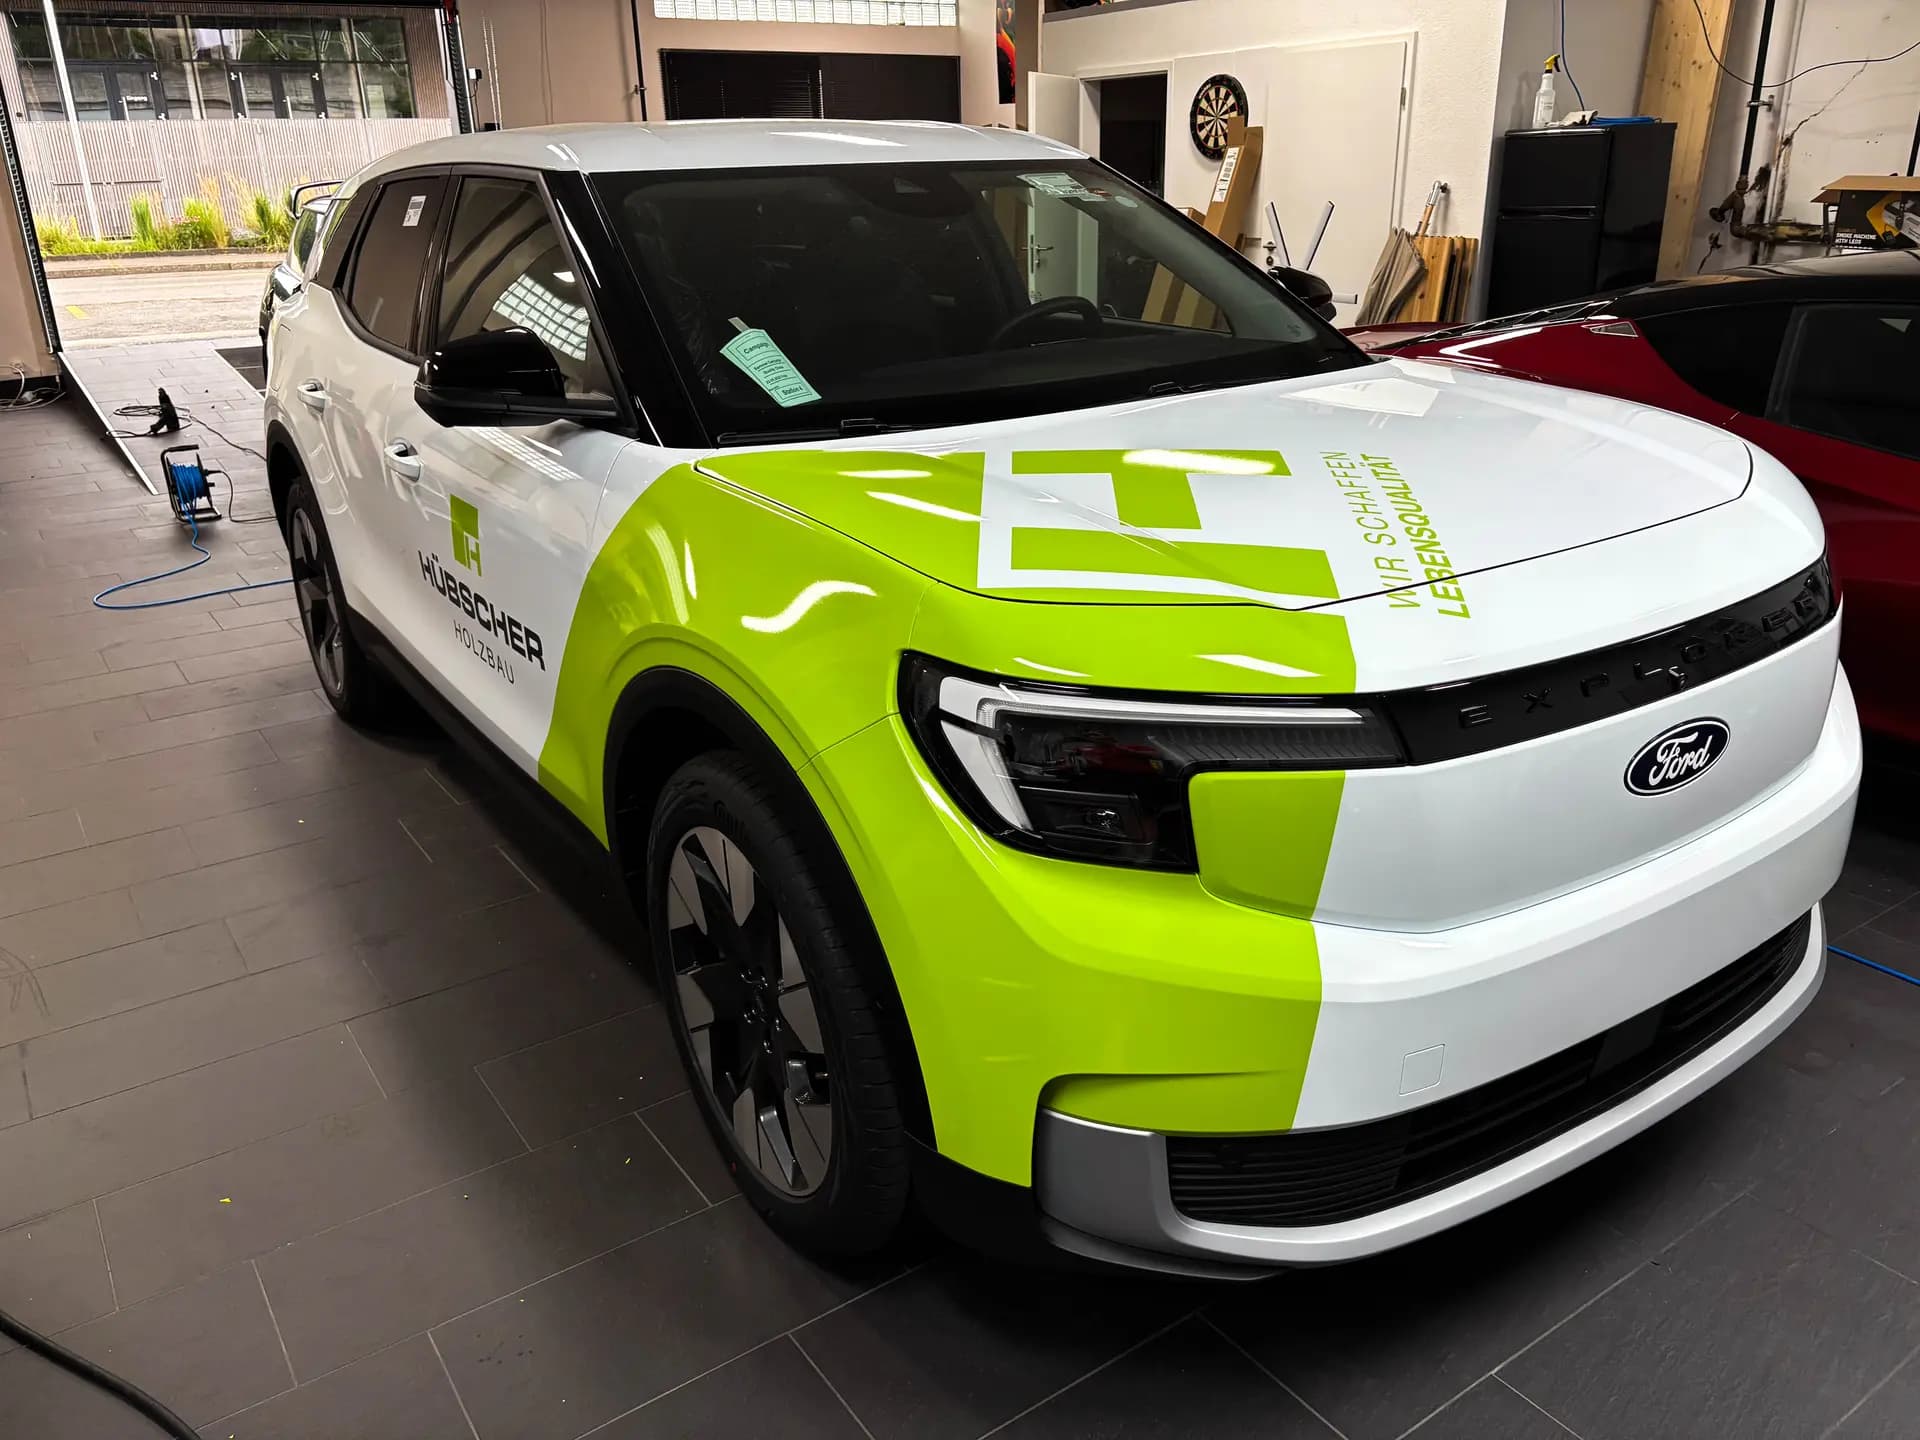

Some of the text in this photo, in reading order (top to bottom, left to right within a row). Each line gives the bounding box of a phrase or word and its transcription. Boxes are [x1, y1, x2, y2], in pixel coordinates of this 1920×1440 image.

[1320, 451, 1421, 608] WIR SCHAFFEN
[1360, 453, 1471, 619] LEBENSQUALITÄT
[418, 550, 546, 671] HÜBSCHER
[453, 619, 515, 684] HOLZBAU
[1459, 587, 1823, 729] EXPLORER
